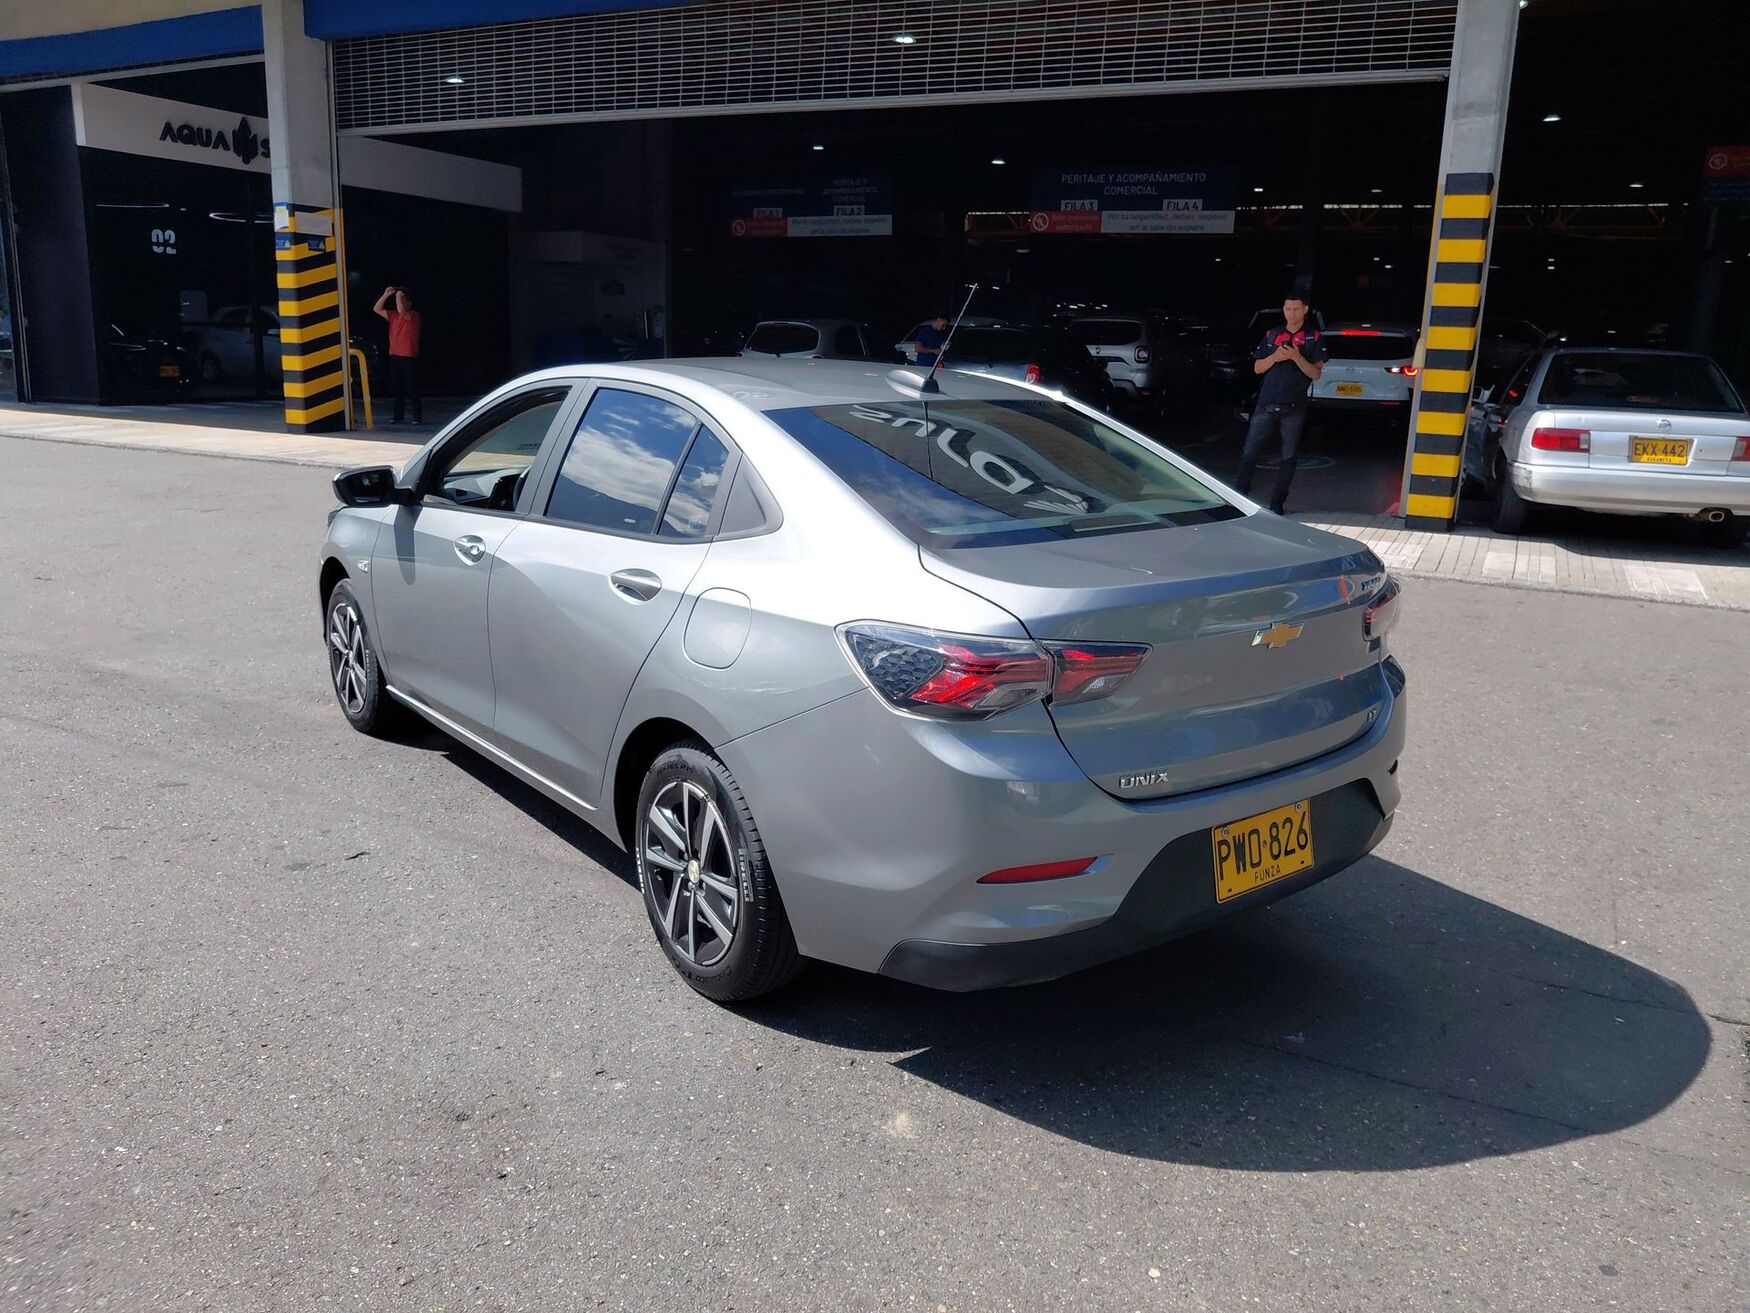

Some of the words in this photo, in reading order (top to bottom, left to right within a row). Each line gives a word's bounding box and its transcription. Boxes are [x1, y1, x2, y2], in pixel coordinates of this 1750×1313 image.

[160, 121, 231, 151] AQUA
[1061, 173, 1106, 184] PERITAJE
[1107, 174, 1114, 183] Y
[1116, 171, 1207, 183] ACOMPAÑAMIENTO
[1104, 185, 1159, 196] COMERCIAL
[1166, 201, 1190, 211] FILA
[1191, 201, 1200, 211] 4
[151, 228, 177, 255] 02
[1119, 768, 1169, 789] ONIX
[1254, 864, 1281, 883] FUNZA
